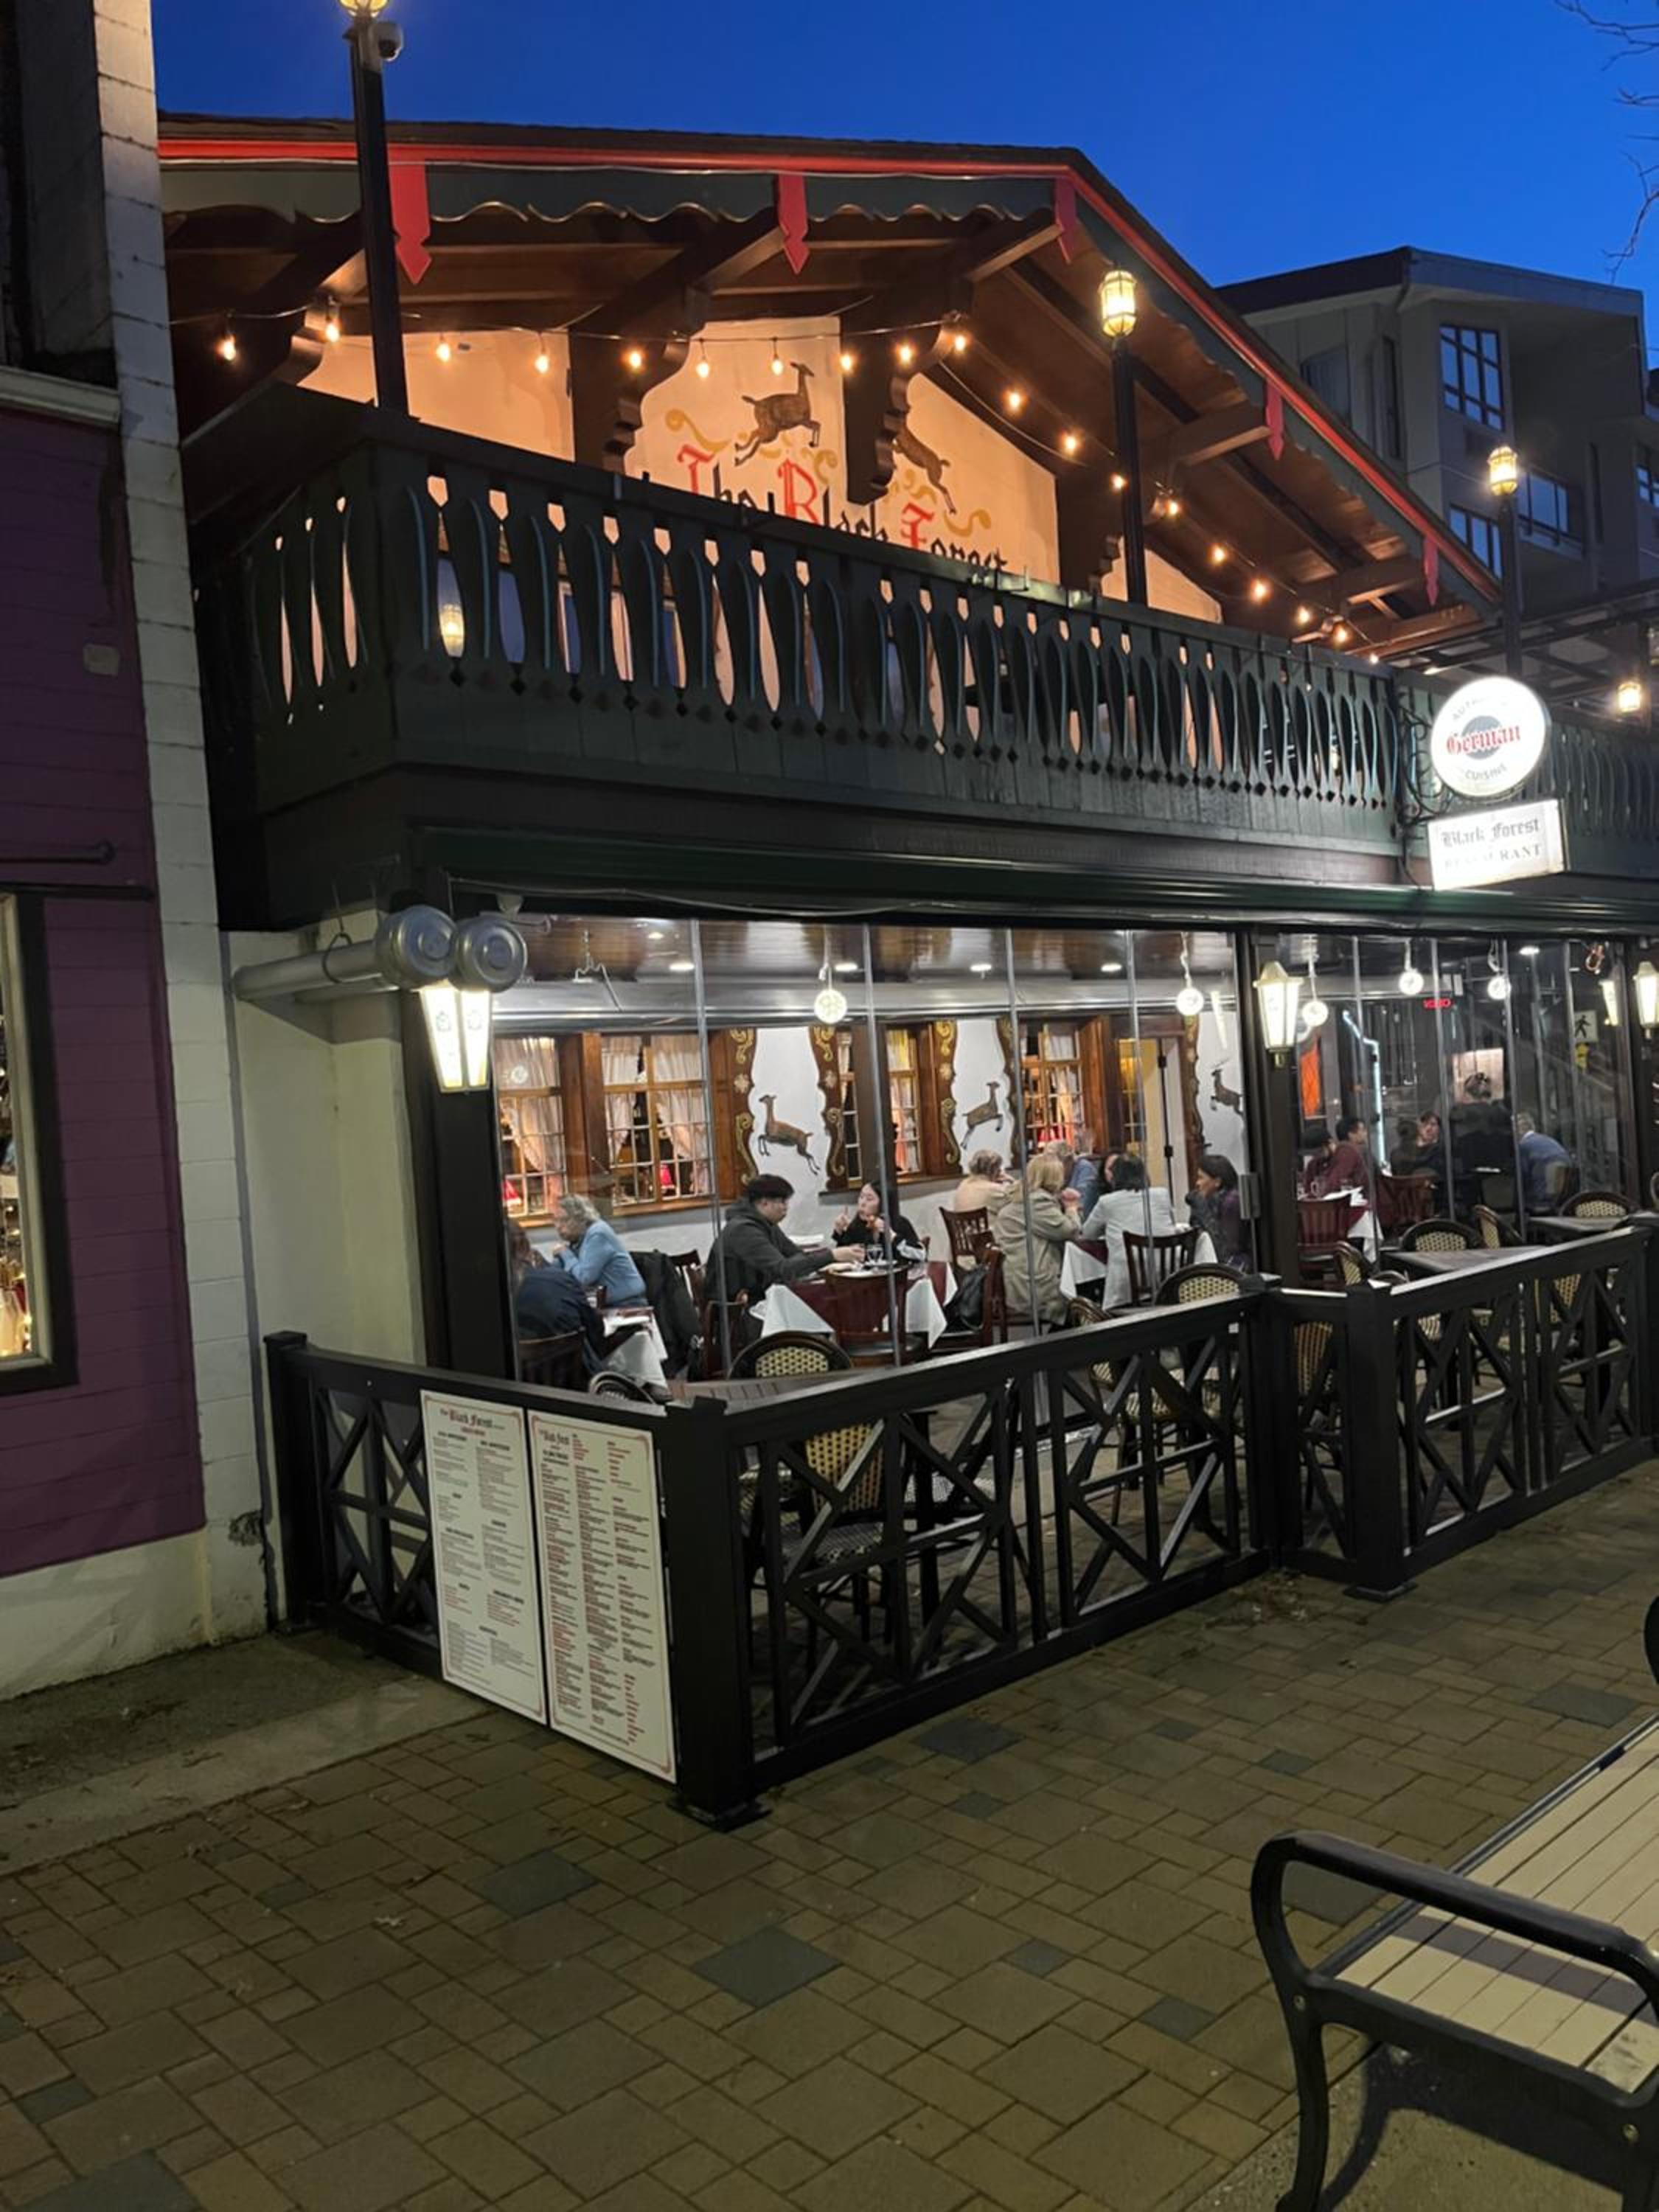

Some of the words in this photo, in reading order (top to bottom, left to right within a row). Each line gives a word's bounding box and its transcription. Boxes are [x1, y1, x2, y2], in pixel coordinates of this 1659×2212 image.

[1446, 725, 1520, 755] German
[1441, 826, 1485, 847] Black
[1492, 818, 1540, 839] Forest
[1444, 843, 1542, 868] REURANT
